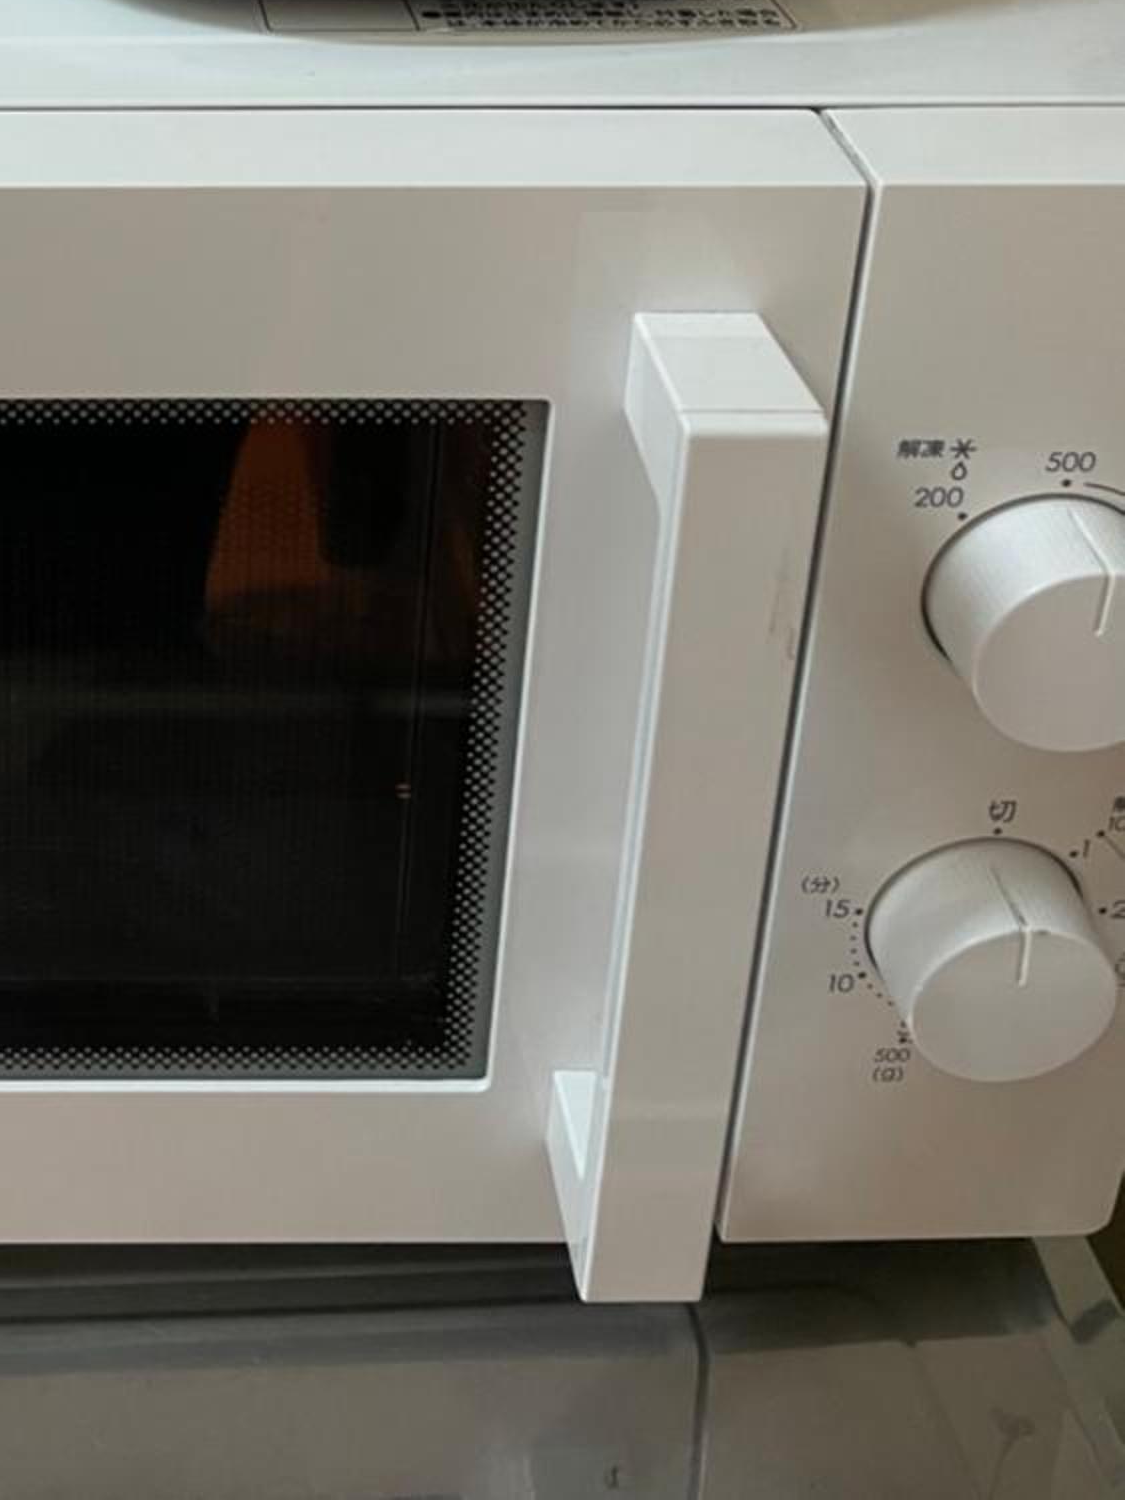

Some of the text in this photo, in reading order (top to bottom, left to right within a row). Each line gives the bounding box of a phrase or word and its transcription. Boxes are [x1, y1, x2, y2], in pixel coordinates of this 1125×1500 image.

[897, 439, 945, 458] 解凍
[1045, 451, 1097, 473] 500
[914, 486, 965, 509] 200
[988, 799, 1017, 823] 切
[1082, 839, 1090, 858] 1
[825, 899, 851, 919] 15
[828, 973, 855, 993] 10
[874, 1047, 911, 1063] 500
